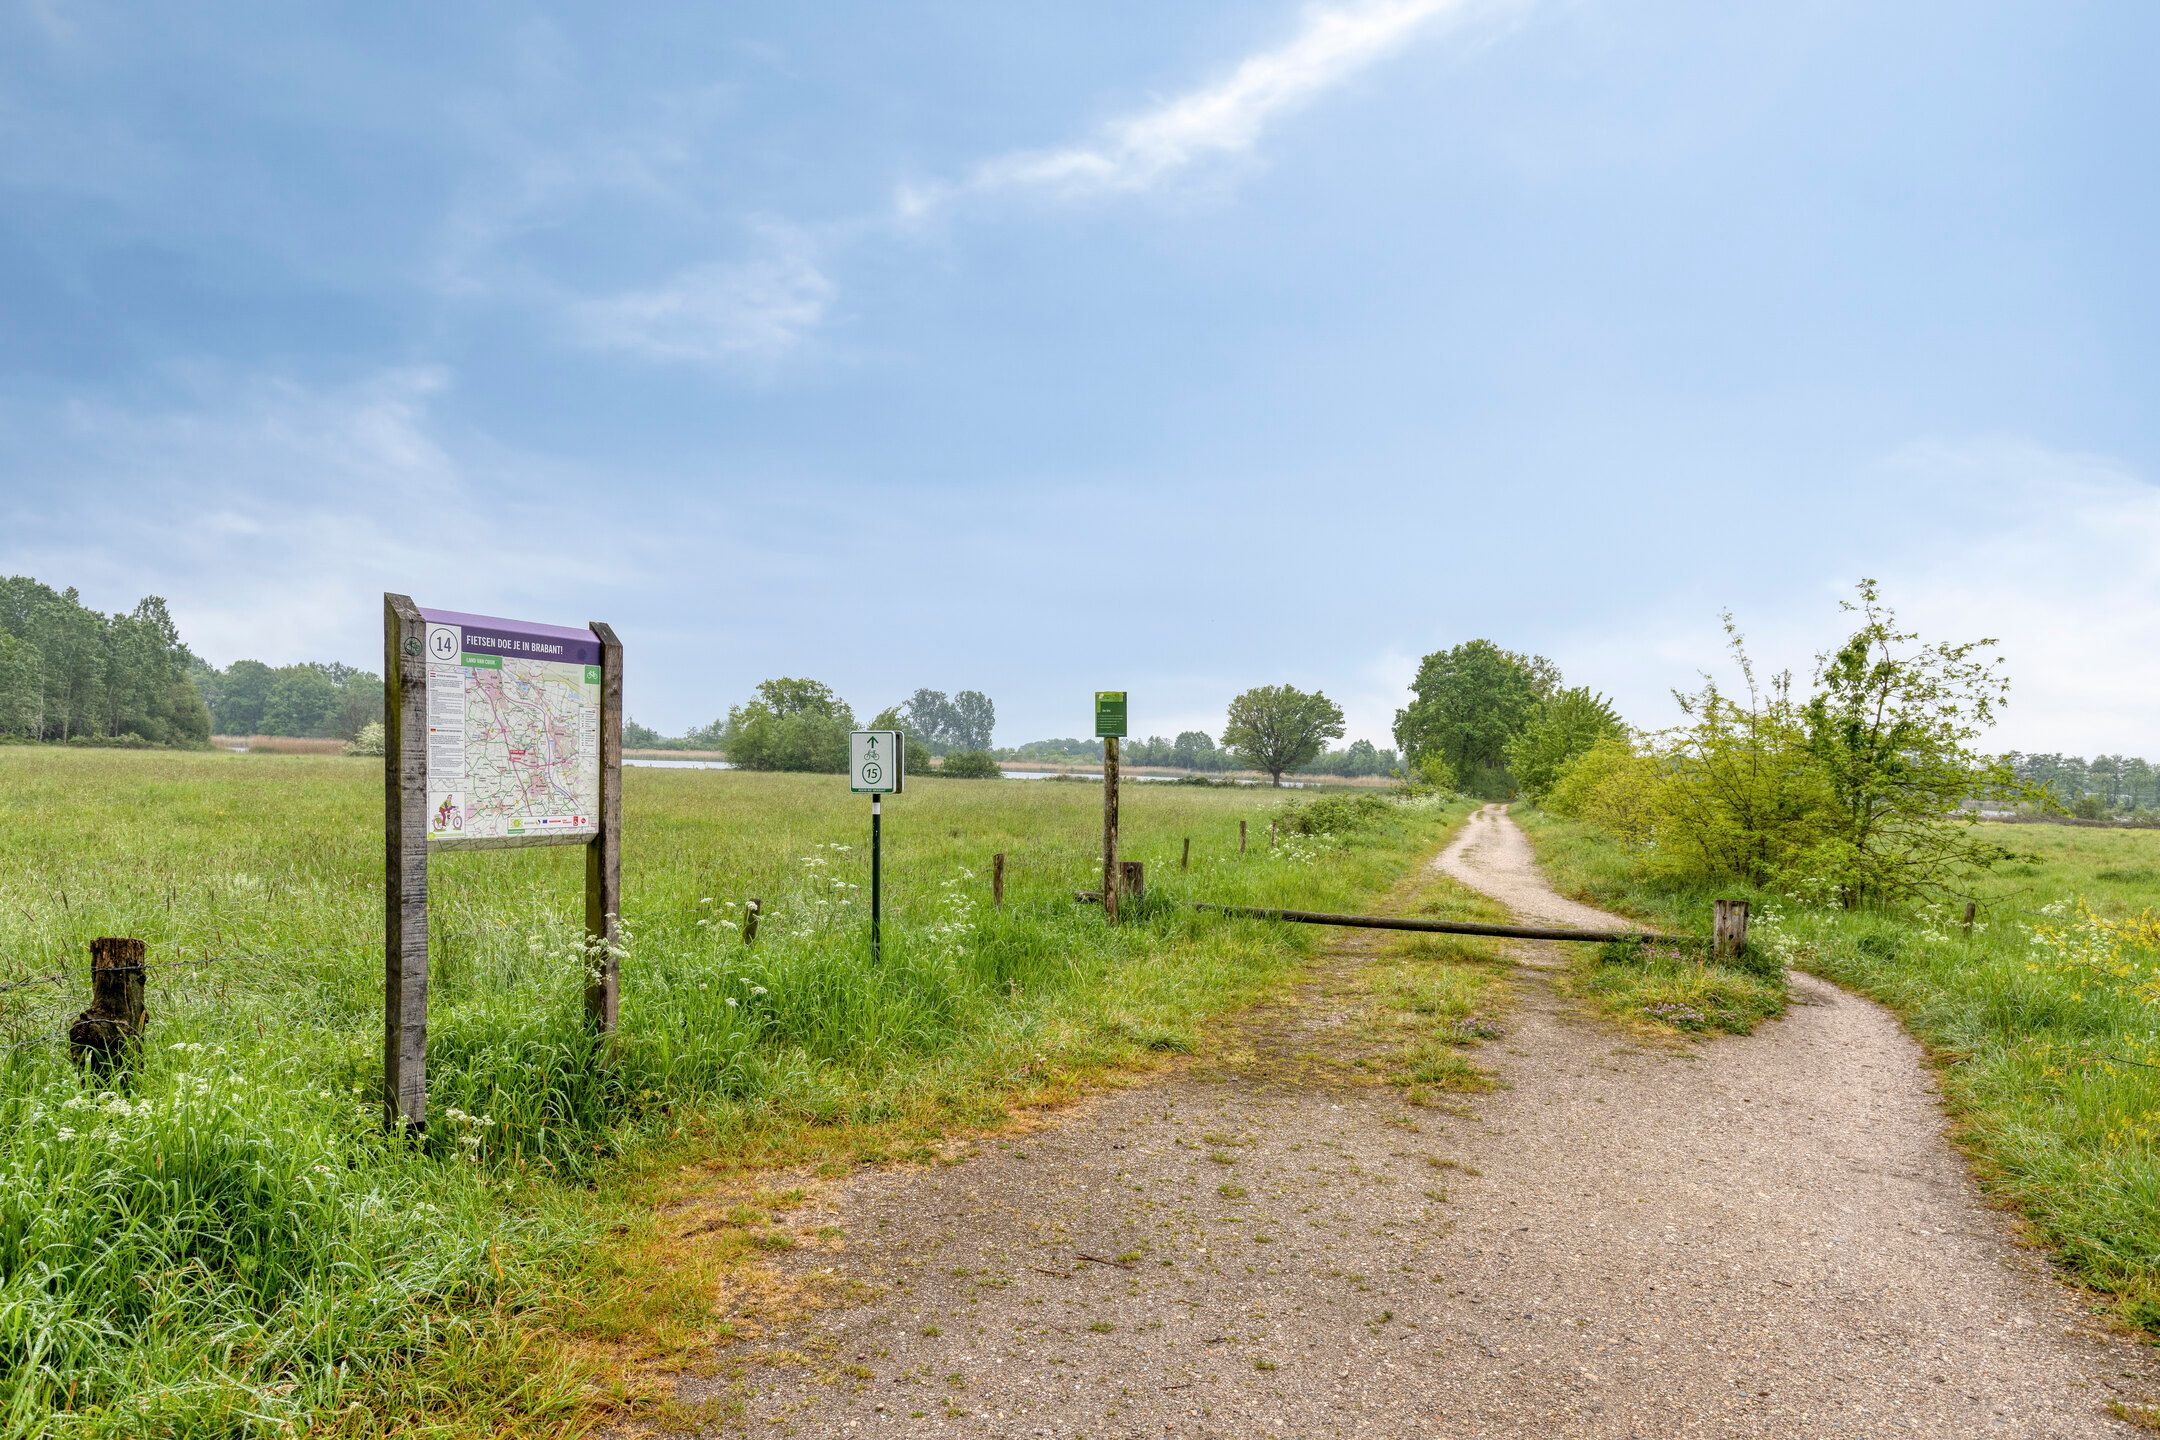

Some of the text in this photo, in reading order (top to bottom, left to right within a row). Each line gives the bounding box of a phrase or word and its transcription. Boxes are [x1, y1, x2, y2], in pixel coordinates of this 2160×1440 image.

[436, 636, 452, 653] 14
[466, 635, 563, 655] FIETSEN DOE JE IN BRABANT!
[866, 768, 878, 779] 15
